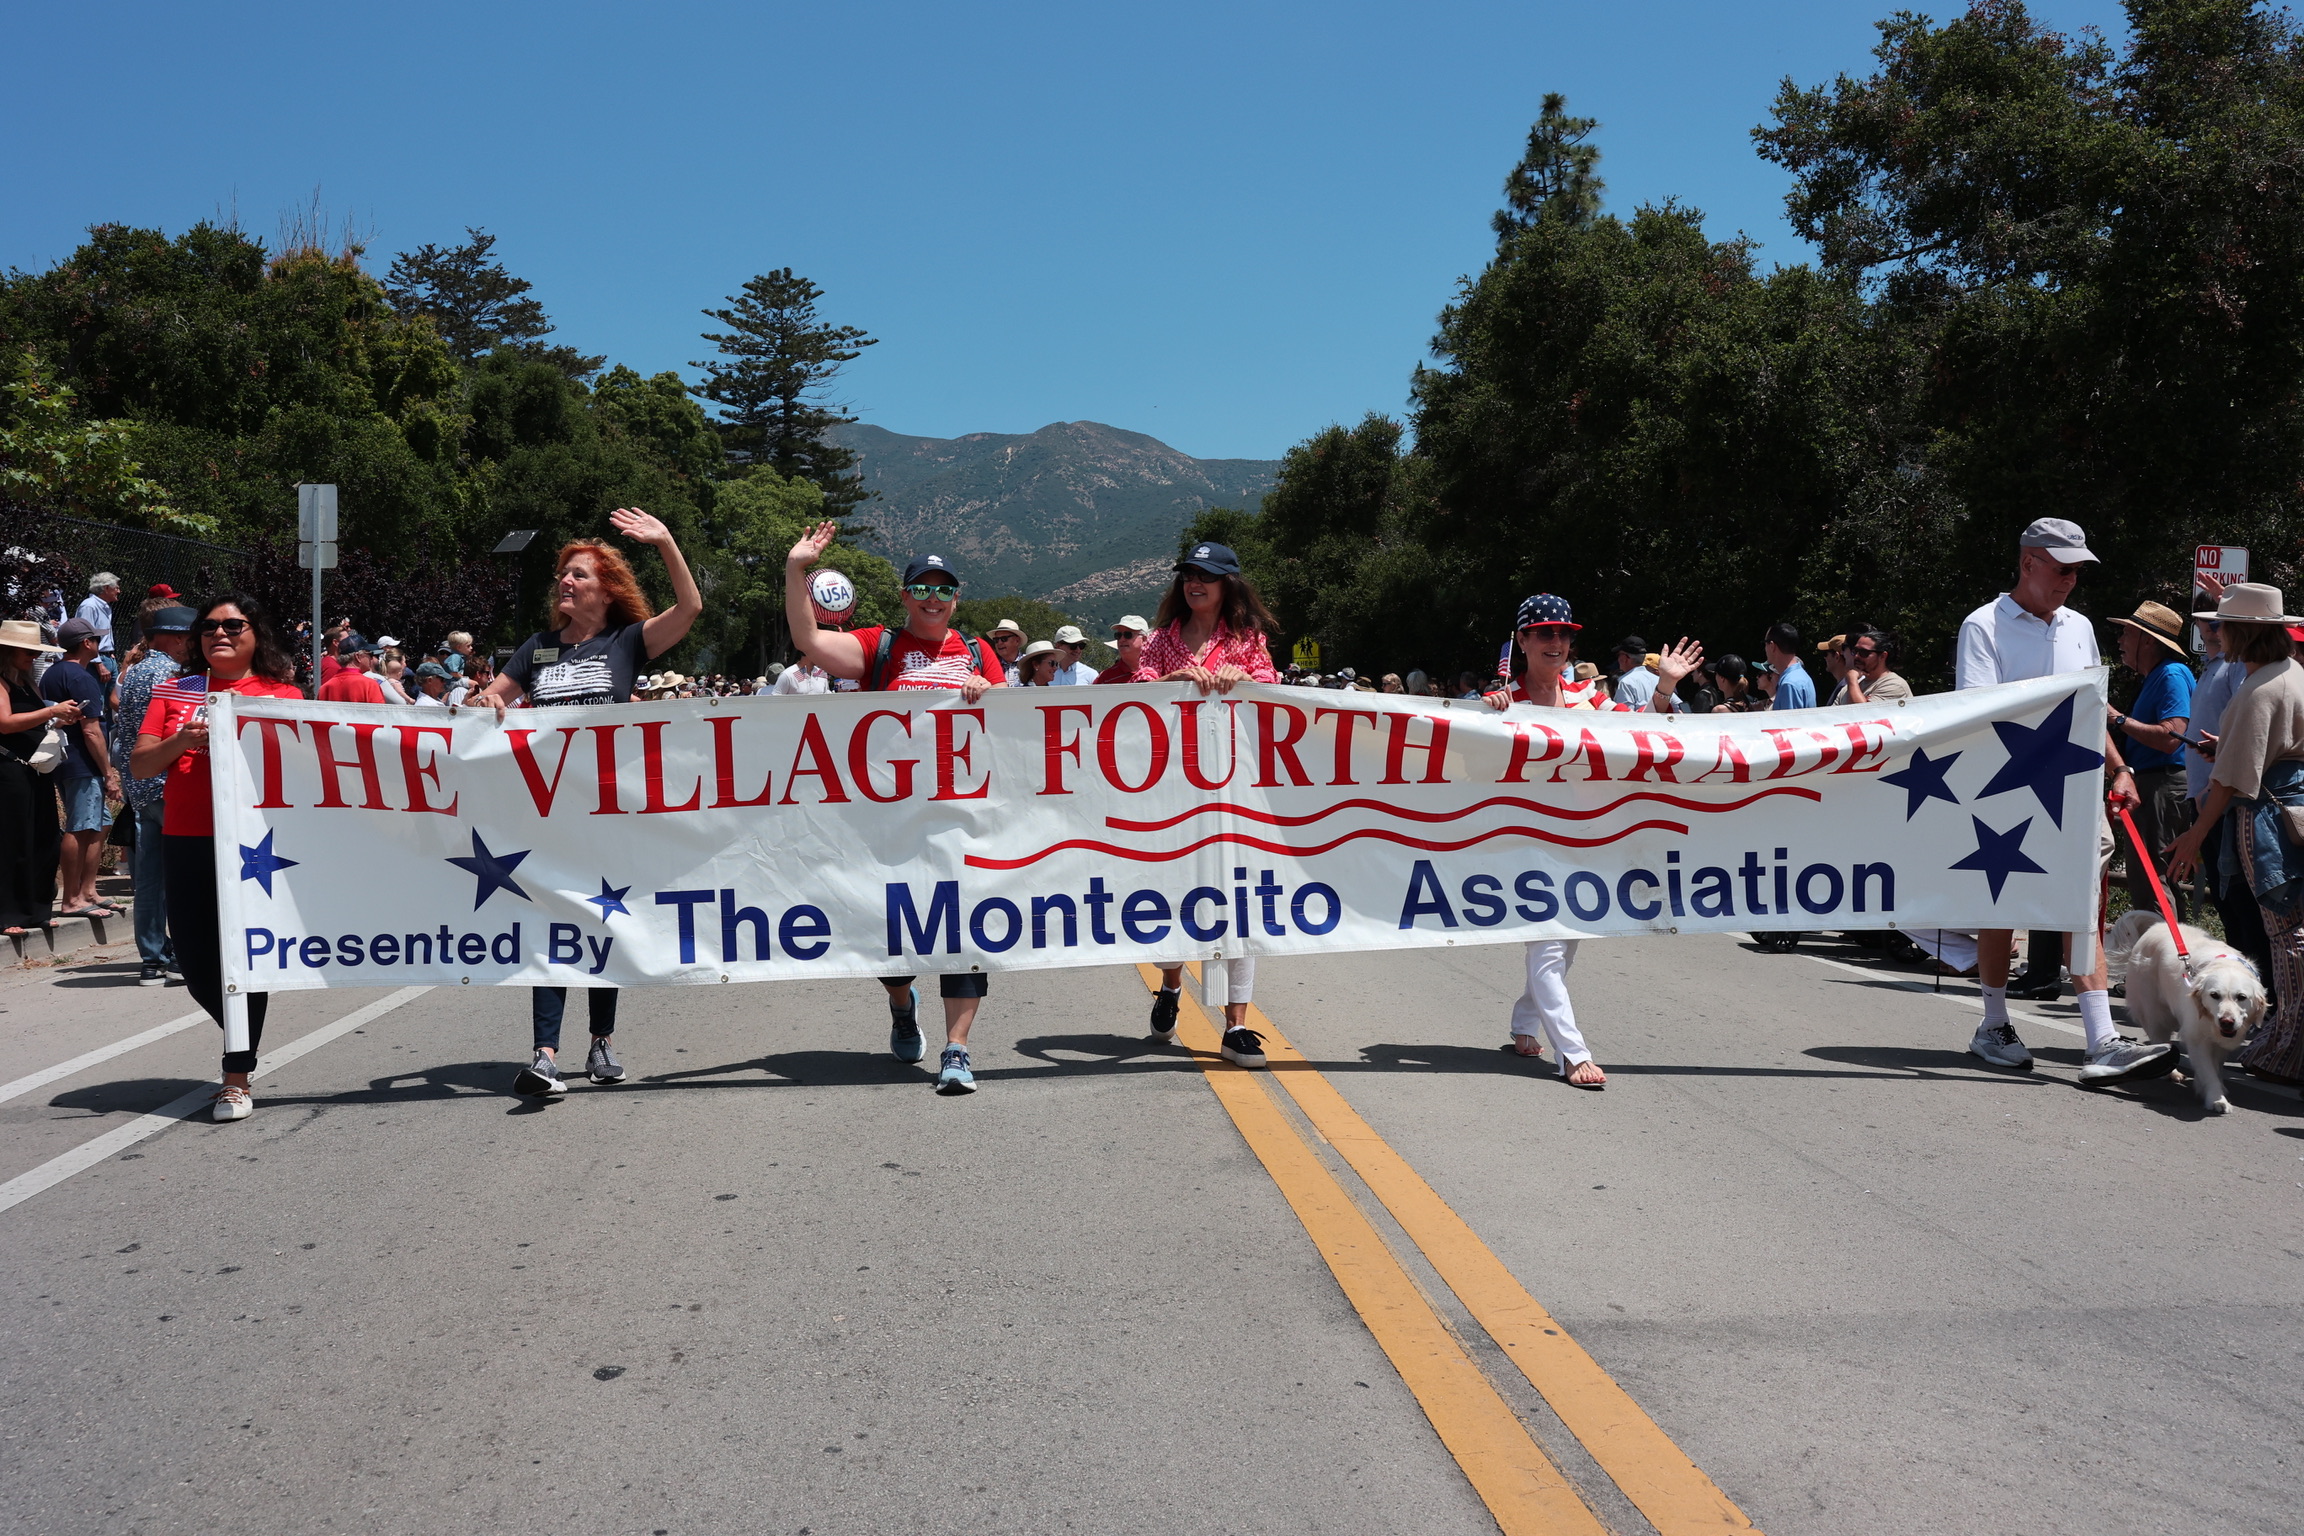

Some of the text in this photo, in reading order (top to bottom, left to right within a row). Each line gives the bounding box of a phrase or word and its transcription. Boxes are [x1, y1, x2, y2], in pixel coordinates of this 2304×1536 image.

[2199, 549, 2217, 565] NO
[820, 586, 850, 603] USA
[2196, 571, 2245, 585] RKING
[235, 699, 1896, 818] THE VILLAGE FOURTH PARADE
[655, 850, 1895, 964] The Montecito Association
[246, 921, 614, 975] Presented By
